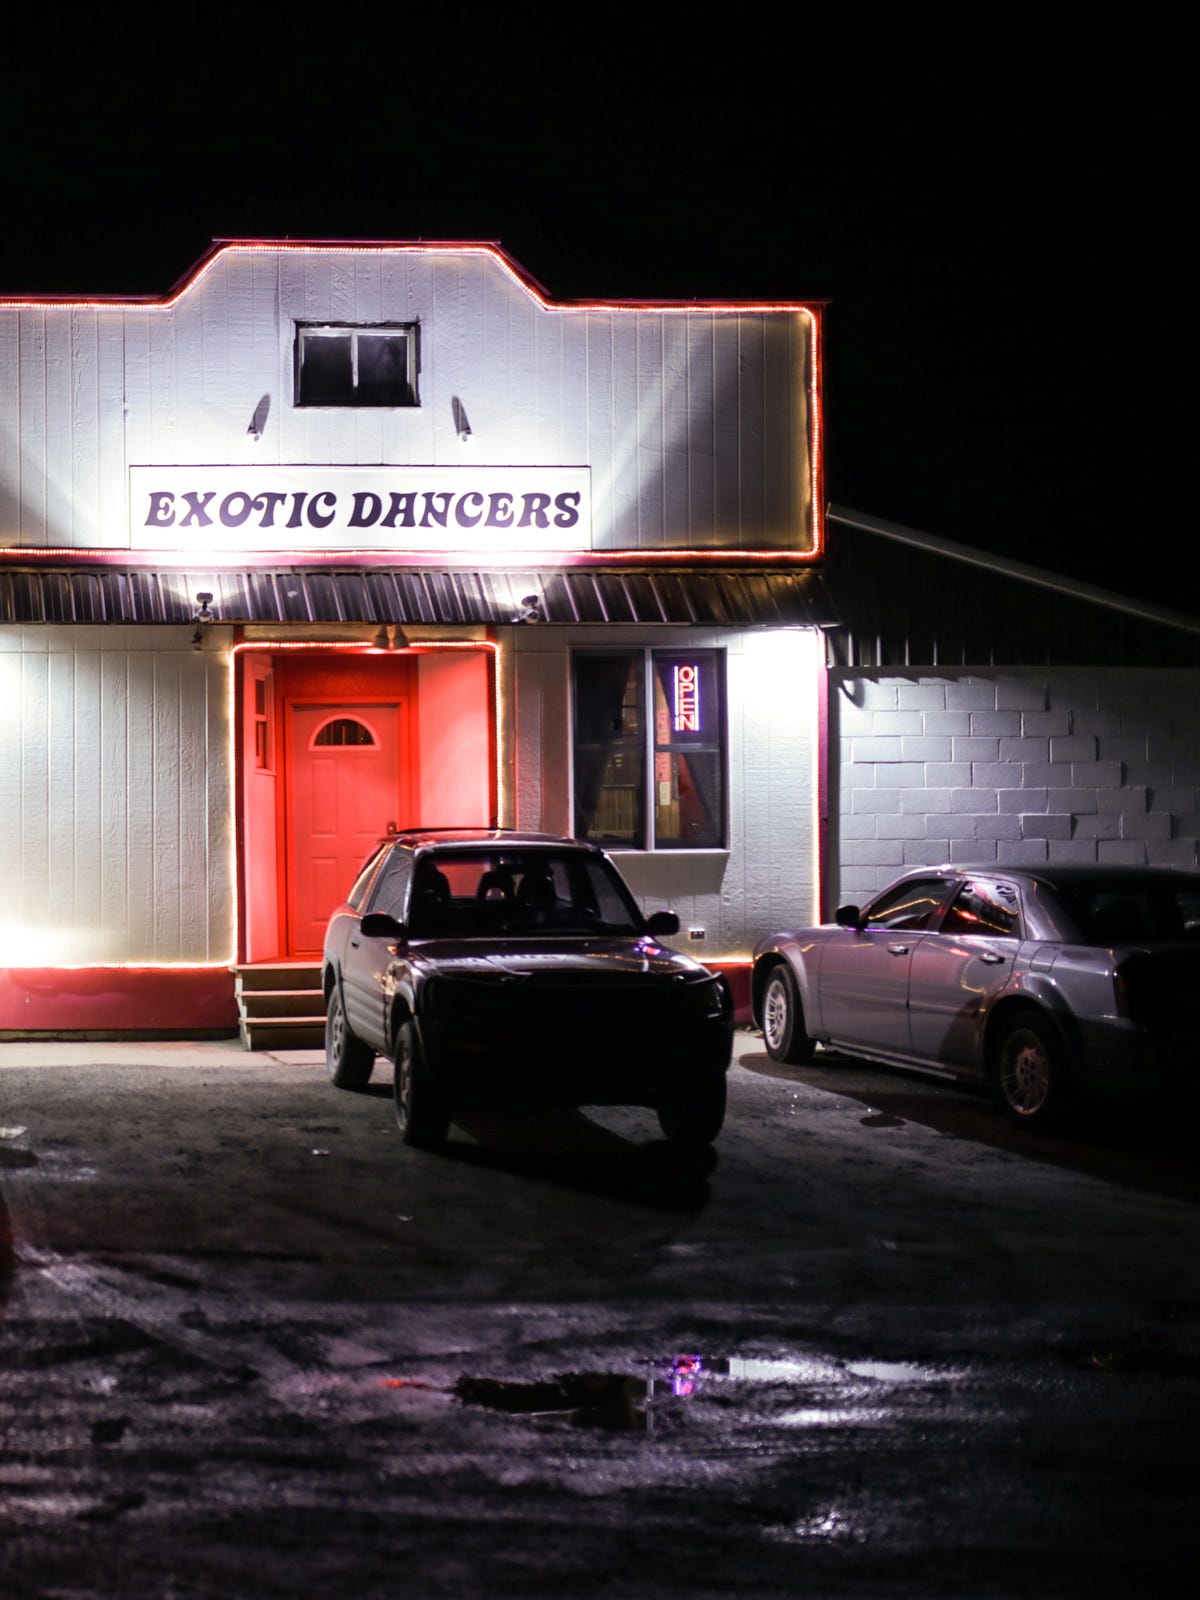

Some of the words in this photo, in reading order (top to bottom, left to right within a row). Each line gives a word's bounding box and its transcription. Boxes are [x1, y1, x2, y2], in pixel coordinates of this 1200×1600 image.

[144, 491, 336, 529] EXOTIC
[347, 491, 581, 529] DANCERS
[678, 665, 695, 731] OPEN
